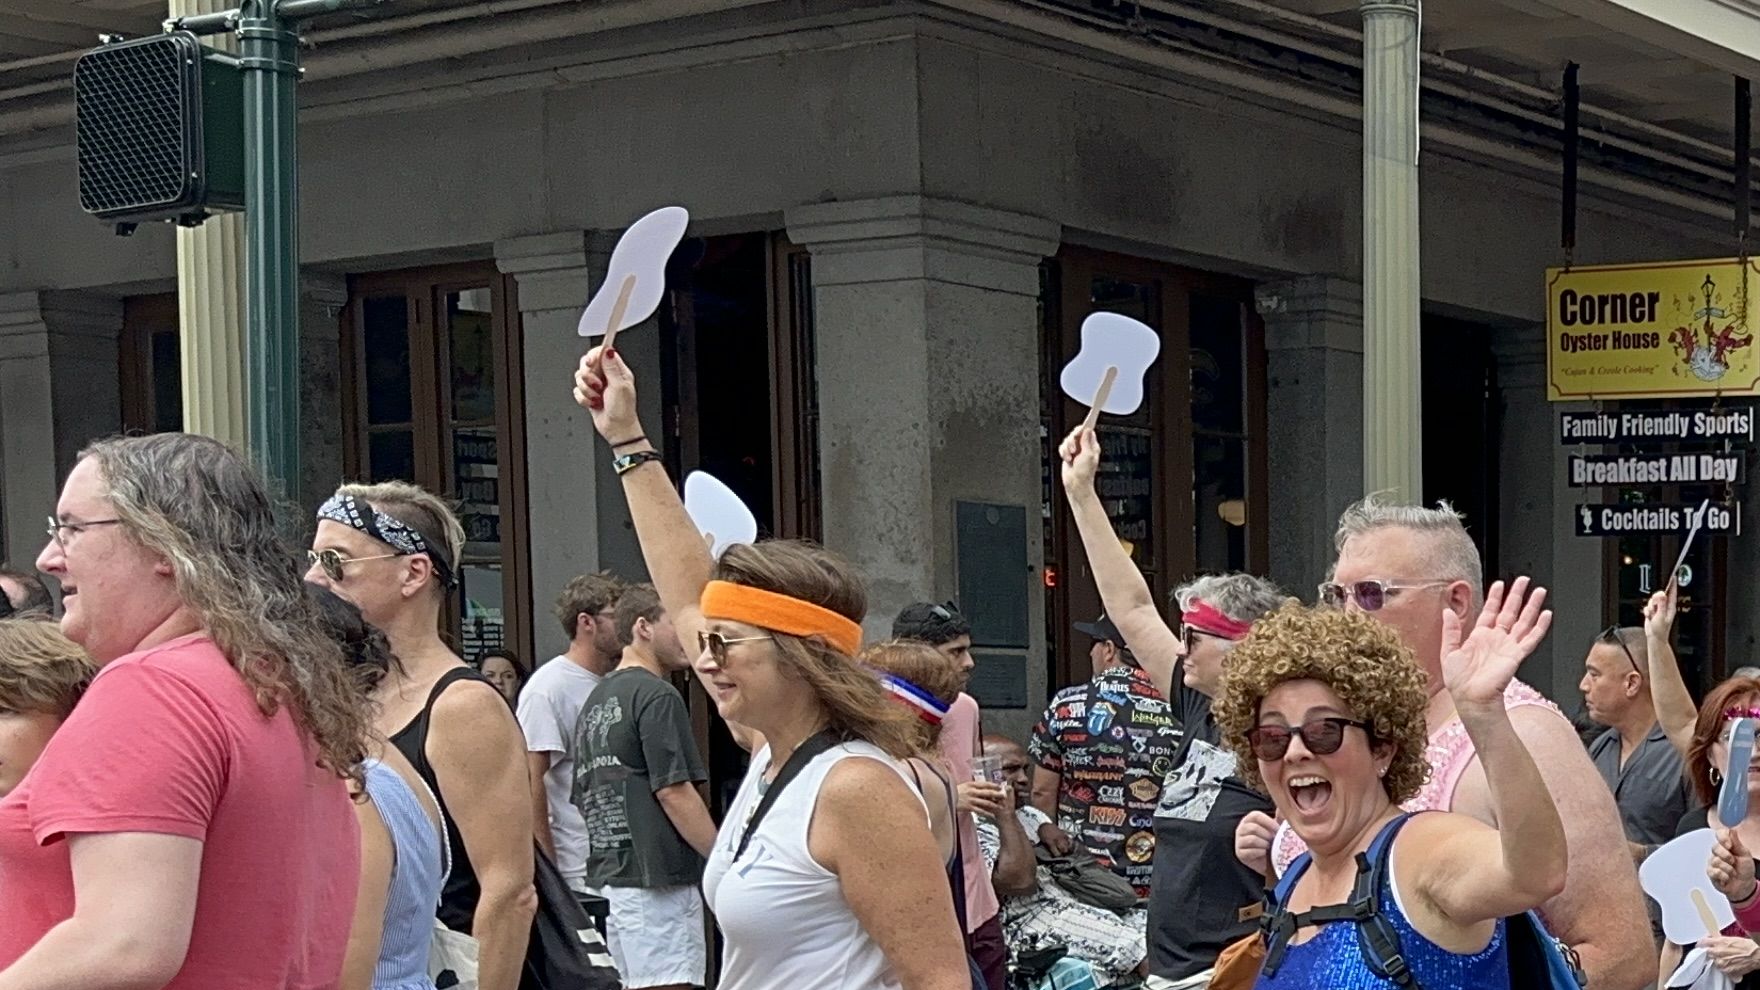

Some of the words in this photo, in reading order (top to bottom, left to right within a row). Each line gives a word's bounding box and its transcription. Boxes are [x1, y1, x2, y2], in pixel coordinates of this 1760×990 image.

[1559, 288, 1660, 327] Corner
[1560, 332, 1609, 354] Oyster
[1612, 330, 1660, 350] House
[1562, 414, 1618, 440] Family
[1622, 412, 1690, 439] Friendly
[1694, 410, 1749, 438] Sports
[1573, 458, 1668, 484] Breakfast
[1670, 456, 1697, 482] All
[1700, 455, 1738, 483] Day
[1601, 508, 1679, 532] Cocktails
[1683, 507, 1703, 530] To
[1707, 506, 1731, 530] Go
